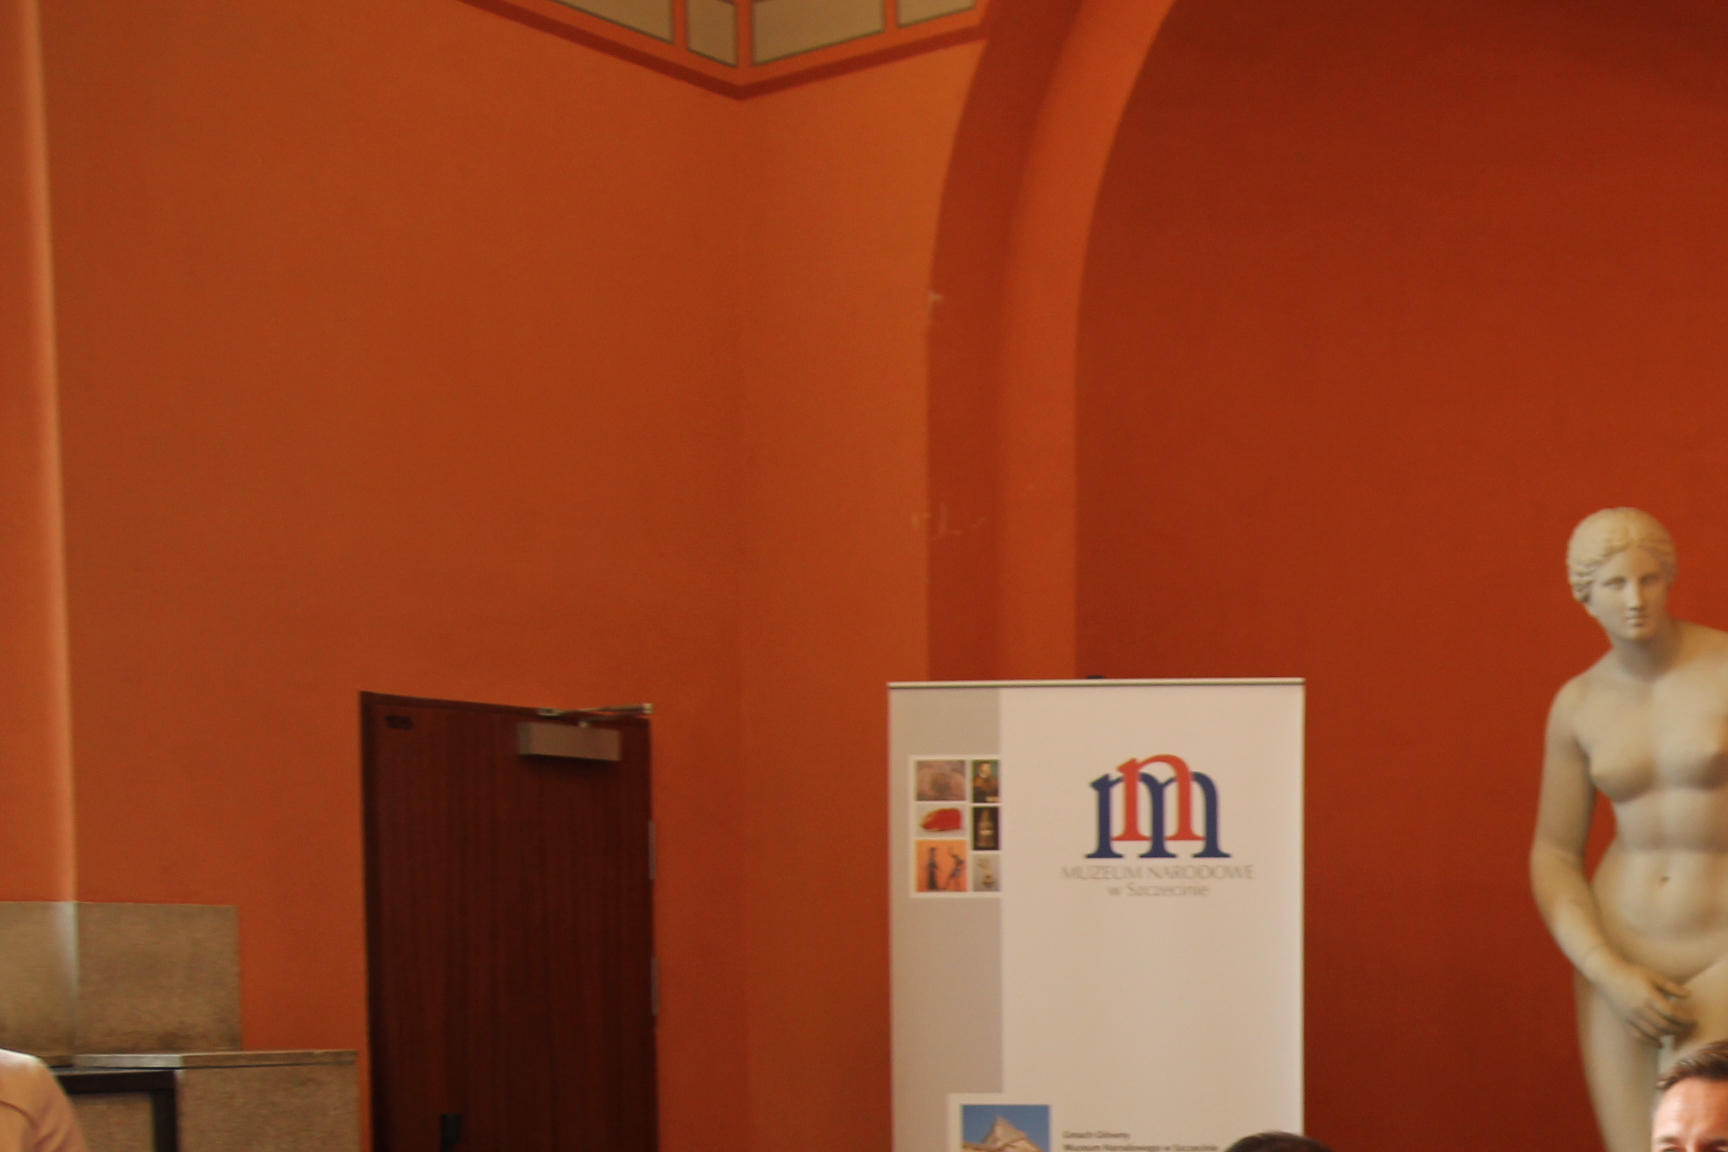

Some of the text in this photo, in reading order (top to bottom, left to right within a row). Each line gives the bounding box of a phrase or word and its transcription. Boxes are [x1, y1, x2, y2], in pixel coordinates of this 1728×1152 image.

[1061, 864, 1255, 881] MUZEUM NARODOWE
[1107, 881, 1210, 897] w Szczecinie
